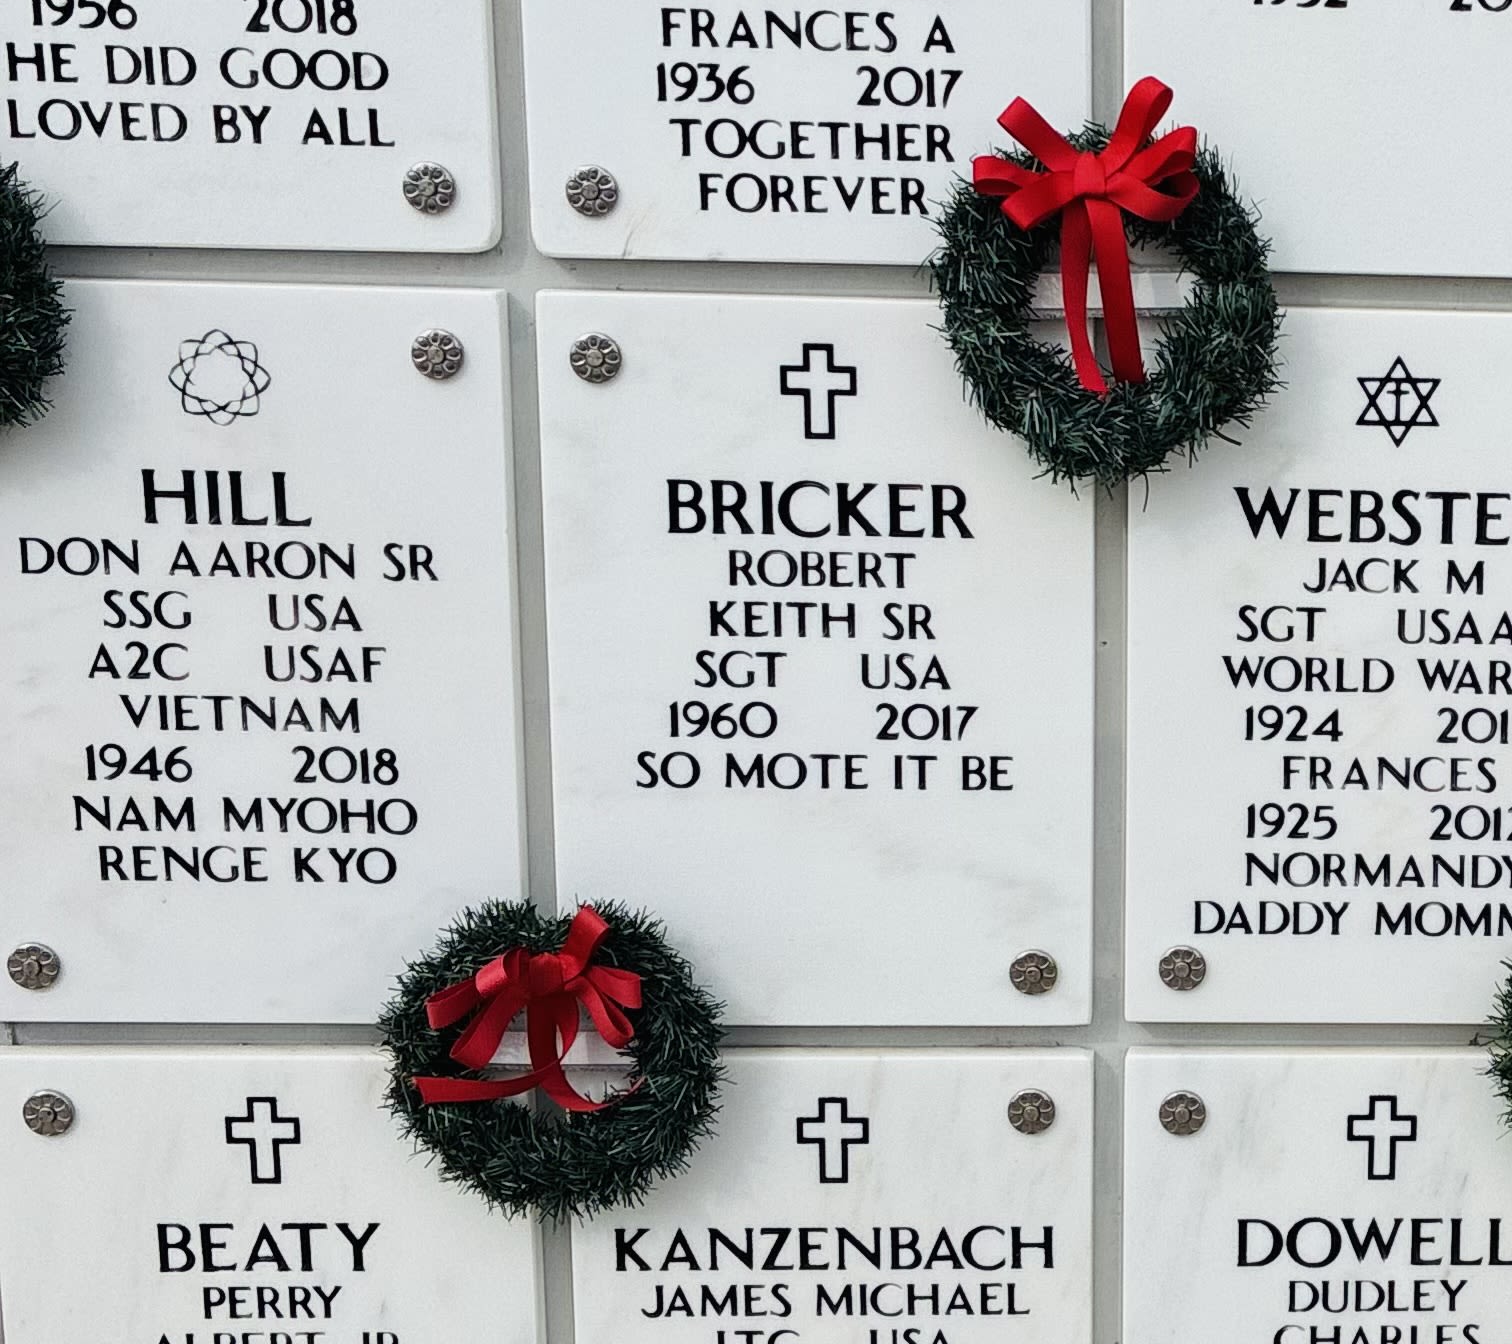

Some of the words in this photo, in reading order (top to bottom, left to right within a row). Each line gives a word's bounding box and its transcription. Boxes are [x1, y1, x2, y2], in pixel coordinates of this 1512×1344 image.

[5, 41, 80, 84] HE
[103, 44, 198, 87] DID
[218, 46, 390, 92] GOOD
[668, 117, 953, 163] TOGETHER
[140, 467, 313, 528] HILL
[665, 478, 976, 540] BRICKER
[18, 536, 141, 577] DON
[168, 539, 356, 581] AARON
[382, 541, 440, 583] SR
[727, 548, 917, 590] ROBERT
[1235, 603, 1328, 644] SGT
[87, 640, 190, 682] A2C
[263, 643, 387, 684] USAF
[1220, 654, 1396, 694] WORLD
[668, 699, 779, 740] 1960
[875, 701, 980, 742] 2017
[635, 749, 702, 790] SO
[724, 751, 870, 791] MOTE
[893, 754, 939, 792] IT
[960, 754, 1015, 792] BE
[71, 794, 197, 833] NAM
[221, 796, 419, 837] MYOHO
[155, 1221, 382, 1274] BEATY
[614, 1224, 1055, 1272] KANZENBACH
[640, 1282, 793, 1319] JAMES
[815, 1281, 1031, 1318] MICHAEL
